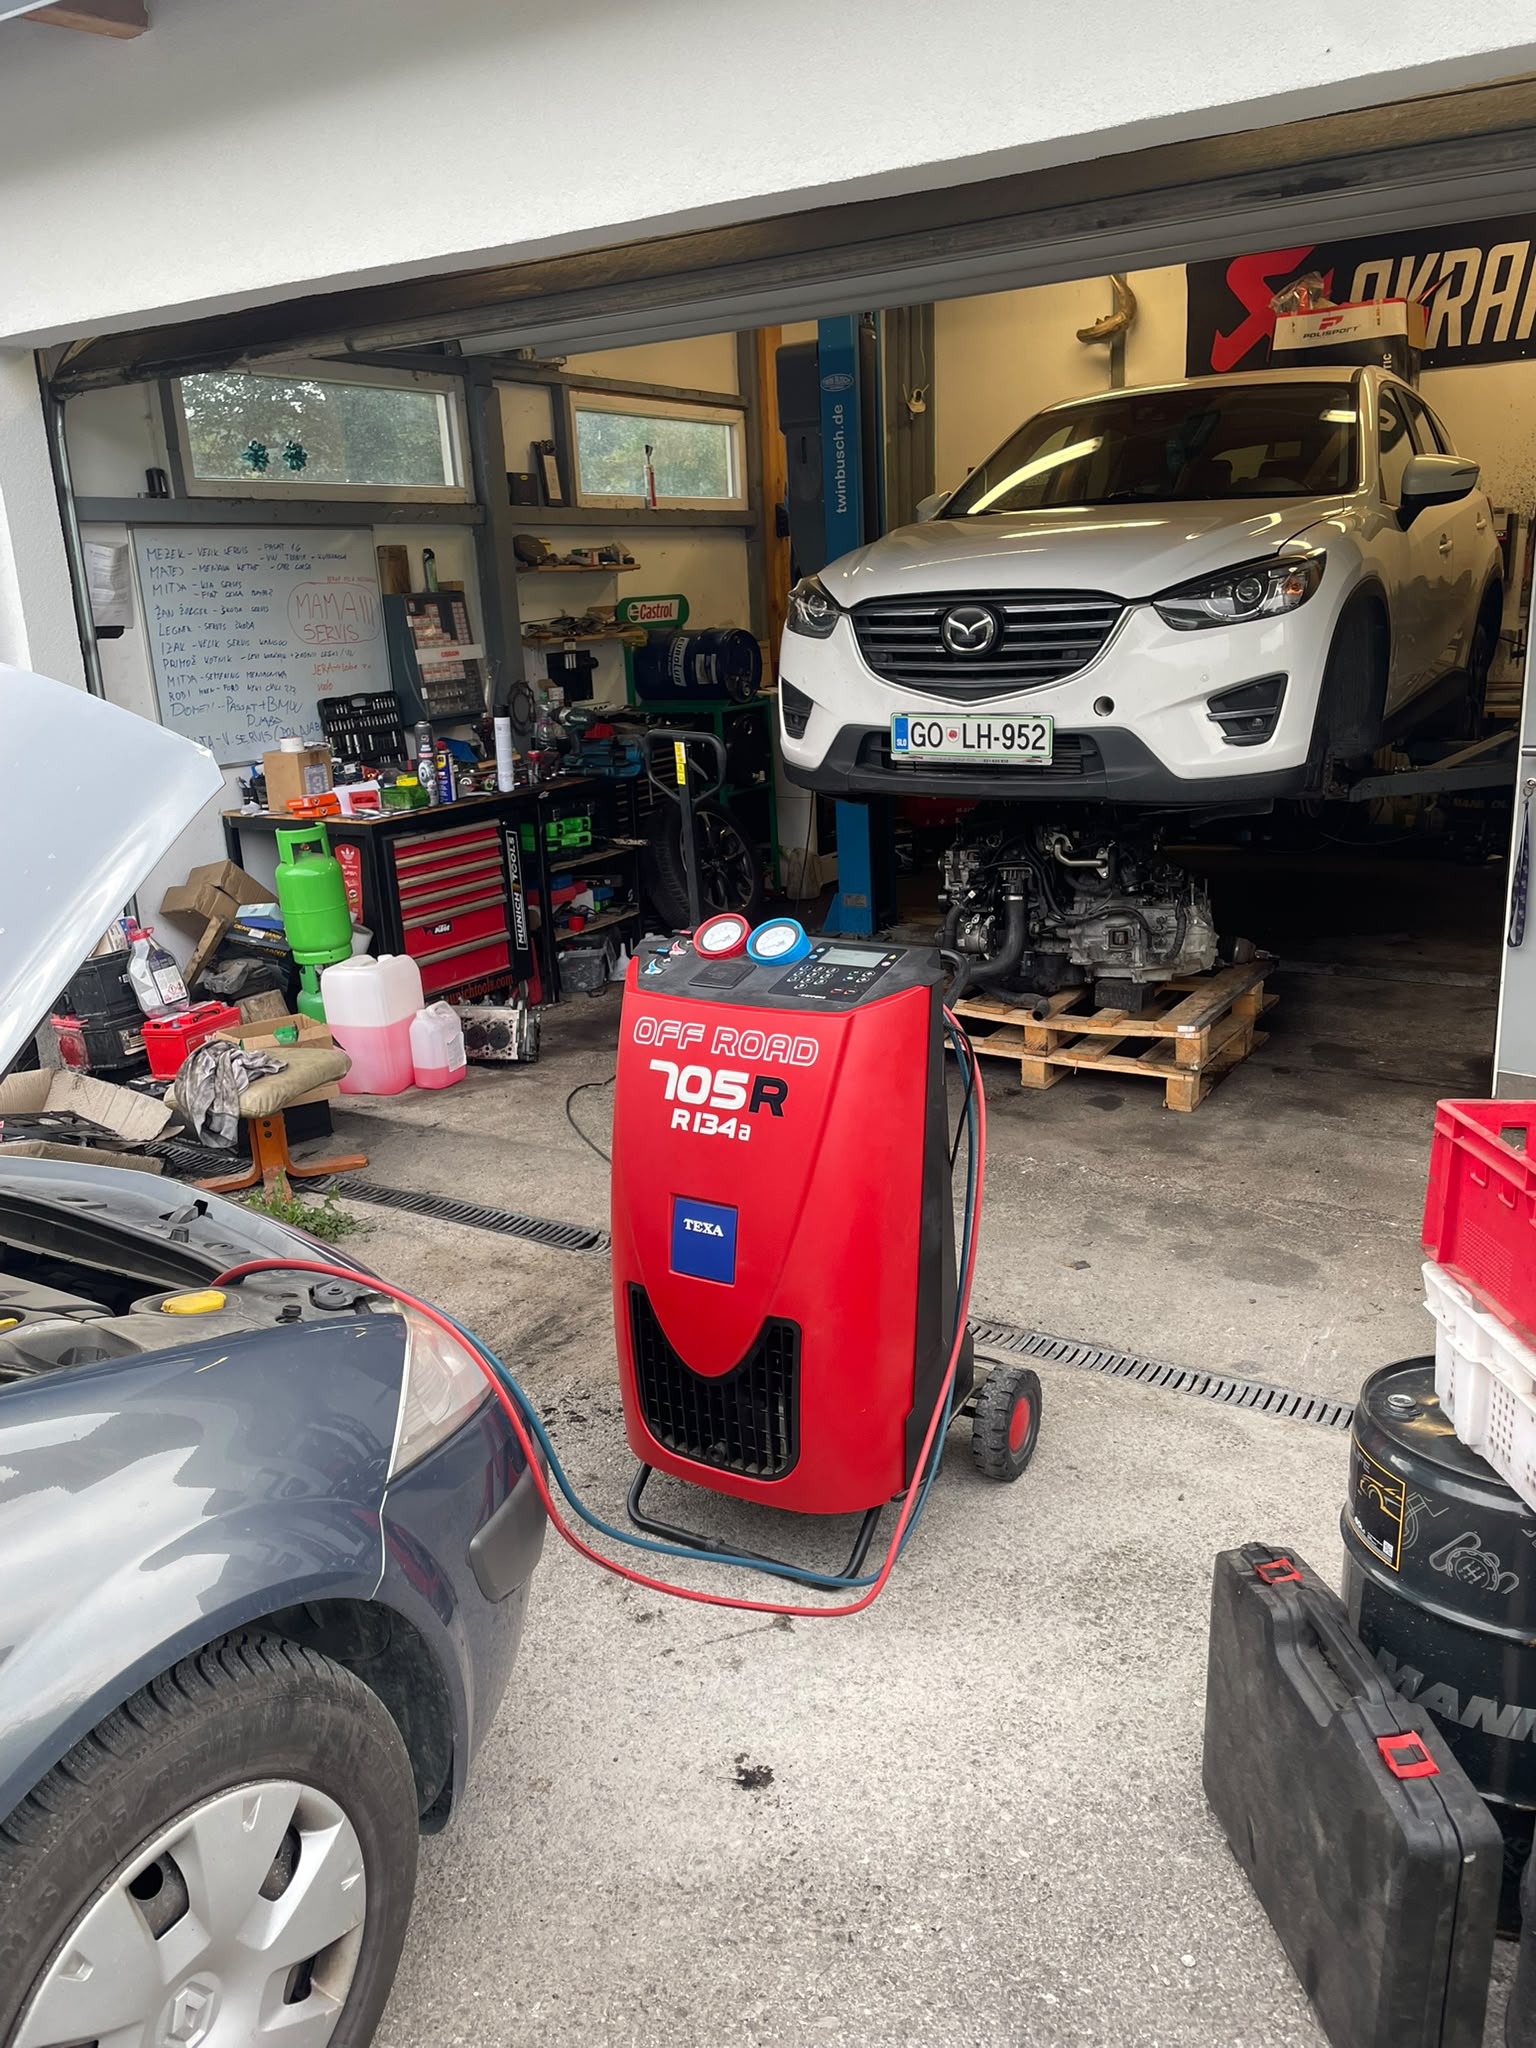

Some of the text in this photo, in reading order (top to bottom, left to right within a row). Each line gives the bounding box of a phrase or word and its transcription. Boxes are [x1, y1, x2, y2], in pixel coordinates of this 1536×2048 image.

[1350, 240, 1536, 350] KRA
[1302, 326, 1359, 339] POLISPORT
[832, 404, 847, 513] twinbusch.de
[201, 590, 218, 599] FIAT
[640, 602, 673, 620] Castrol
[304, 624, 359, 643] SERVIS
[223, 683, 240, 693] FORD
[896, 738, 907, 746] SLO
[910, 721, 1046, 750] GO LH-952
[508, 836, 527, 944] MUNICH TOOLS
[434, 923, 451, 934] KTM
[632, 1016, 819, 1067] OFF ROAD
[649, 1059, 789, 1117] 705R
[683, 1217, 724, 1238] TEXA
